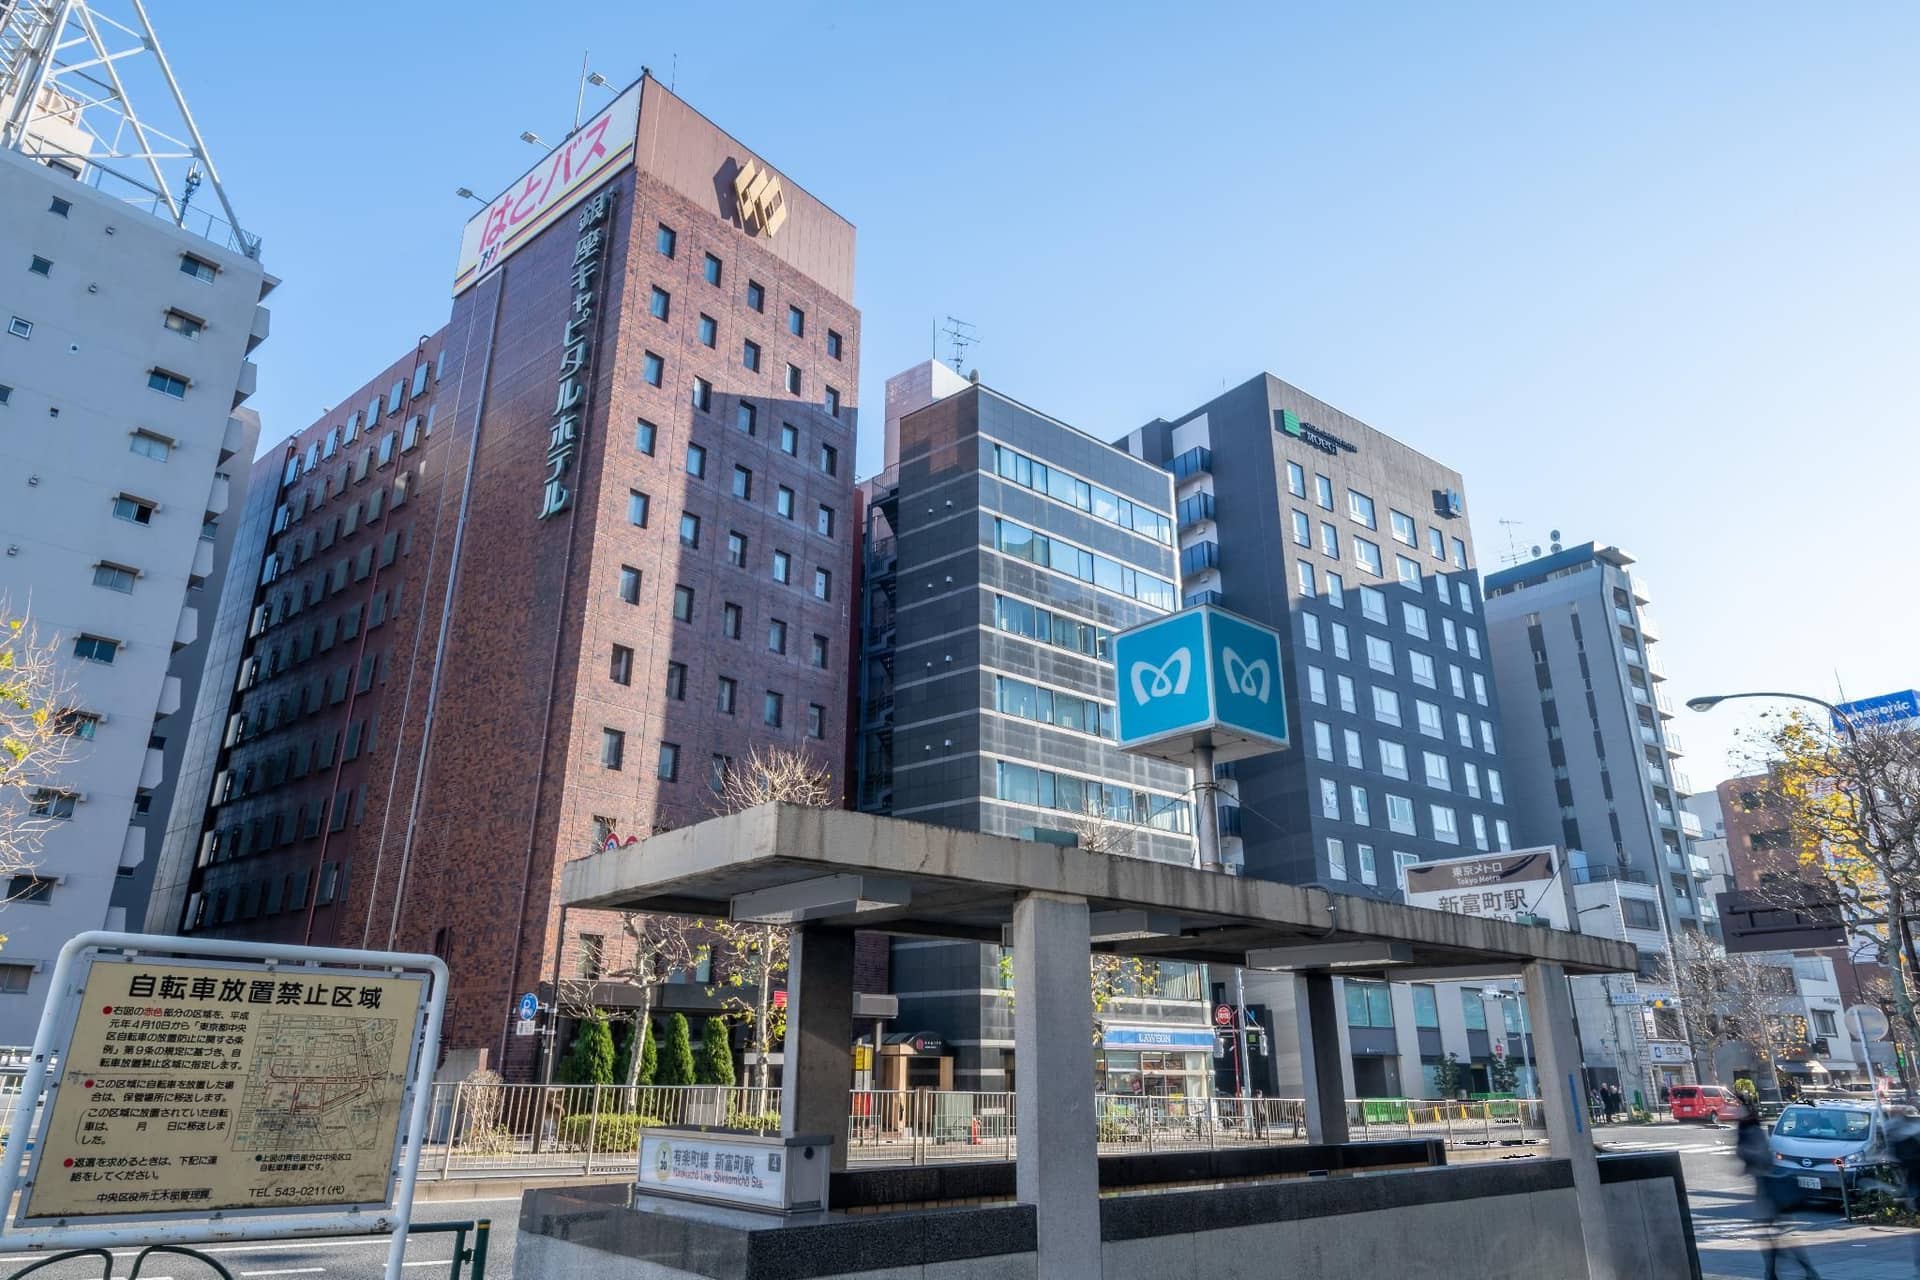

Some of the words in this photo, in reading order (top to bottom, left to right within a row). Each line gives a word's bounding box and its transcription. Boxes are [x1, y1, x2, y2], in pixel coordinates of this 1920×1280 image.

[479, 113, 612, 252] はとバス
[538, 193, 607, 520] 銀座キャピタルホテル
[1453, 862, 1503, 877] 東京メトロ
[1457, 876, 1479, 885] Tokyo
[1479, 874, 1501, 883] Metro
[1438, 888, 1529, 914] 新富町駅
[128, 972, 383, 1010] 自転車放置禁止区域
[1138, 1033, 1171, 1043] LAWSON
[135, 1121, 147, 1132] 月
[714, 1151, 755, 1175] 新富町駅
[249, 1187, 271, 1198] TEL
[275, 1185, 345, 1197] 543-0211(代)
